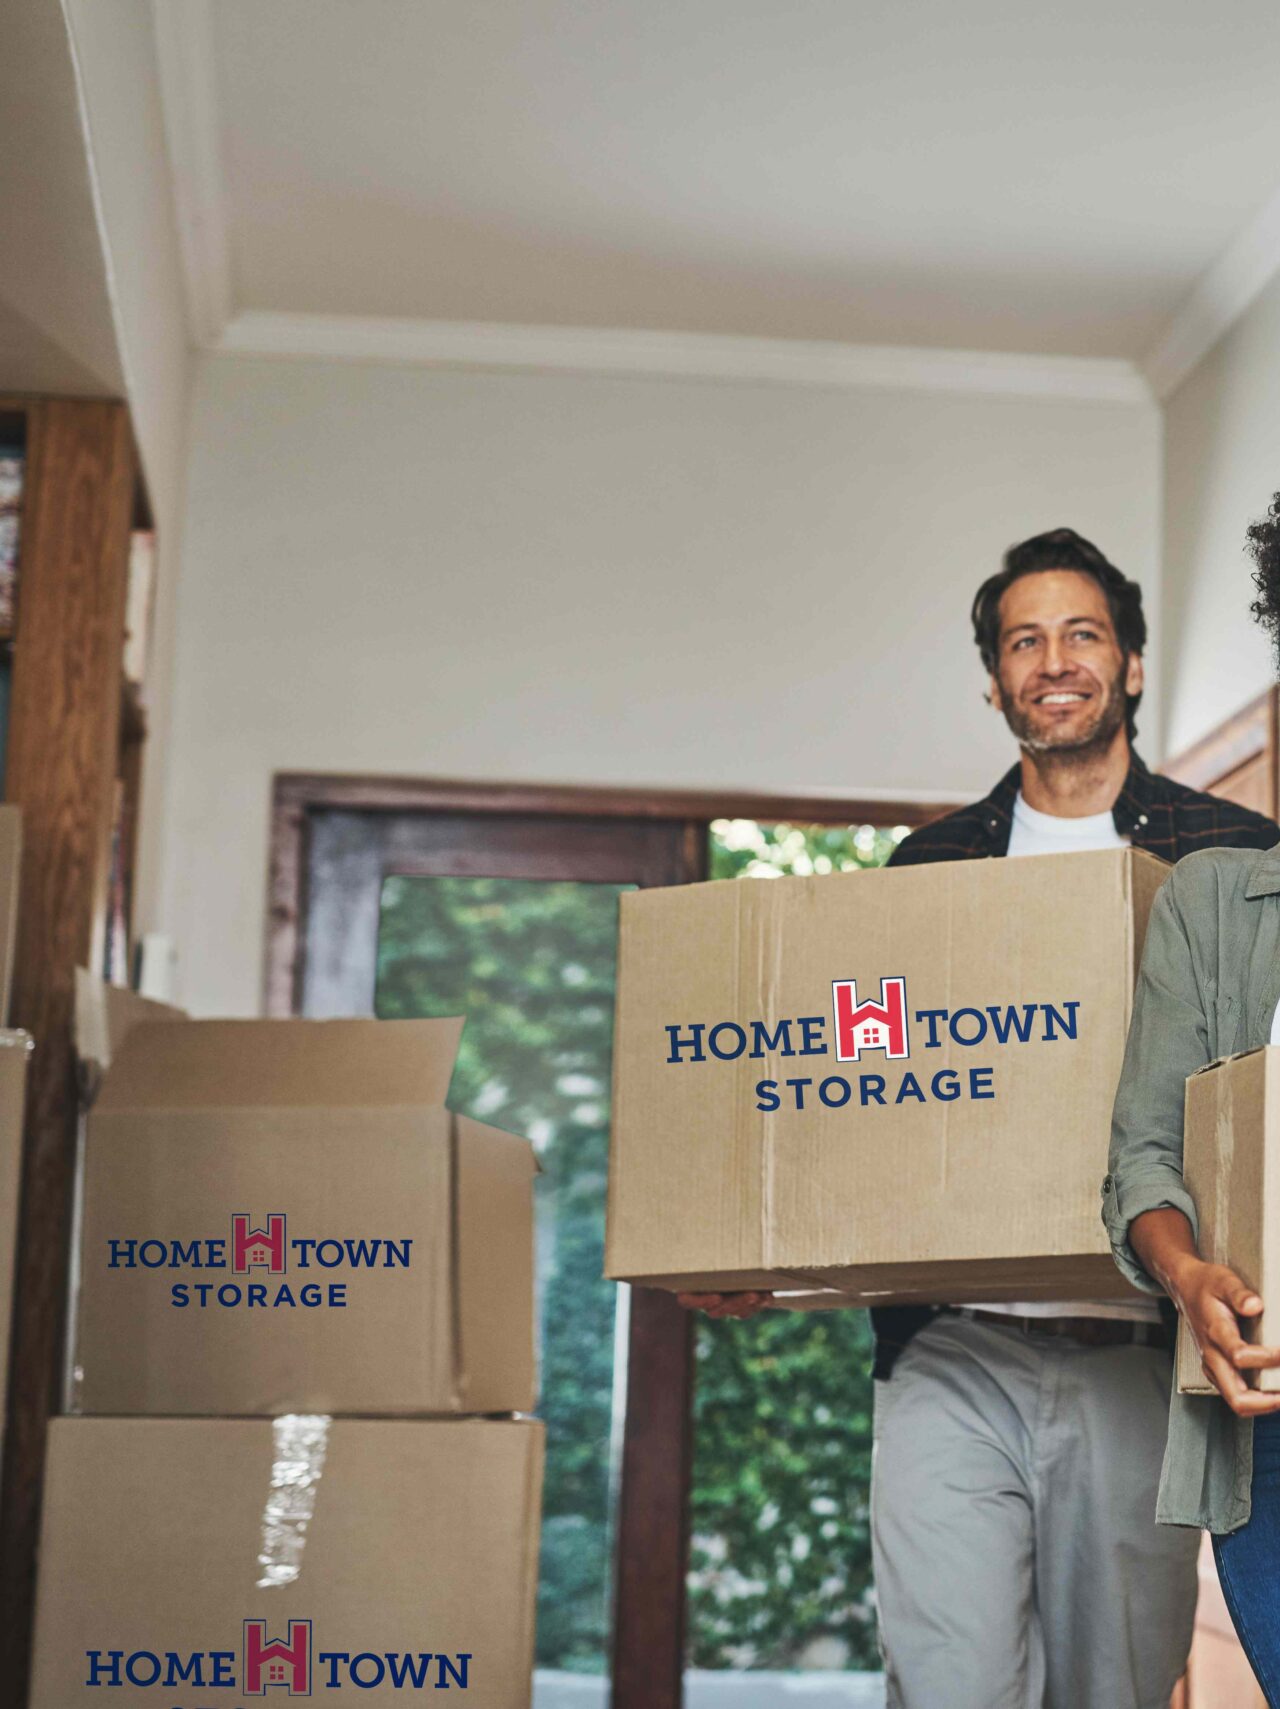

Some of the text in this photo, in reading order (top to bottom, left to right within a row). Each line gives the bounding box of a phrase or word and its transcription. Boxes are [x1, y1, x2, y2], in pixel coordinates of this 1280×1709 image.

[664, 1017, 828, 1064] HOME
[916, 1001, 1080, 1049] TOWN
[756, 1068, 995, 1112] STORAGE
[108, 1239, 226, 1268] HOME
[291, 1239, 413, 1268] TOWN
[171, 1283, 346, 1308] STORAGE
[85, 1651, 236, 1687] HOME
[319, 1653, 472, 1689] TOWN
